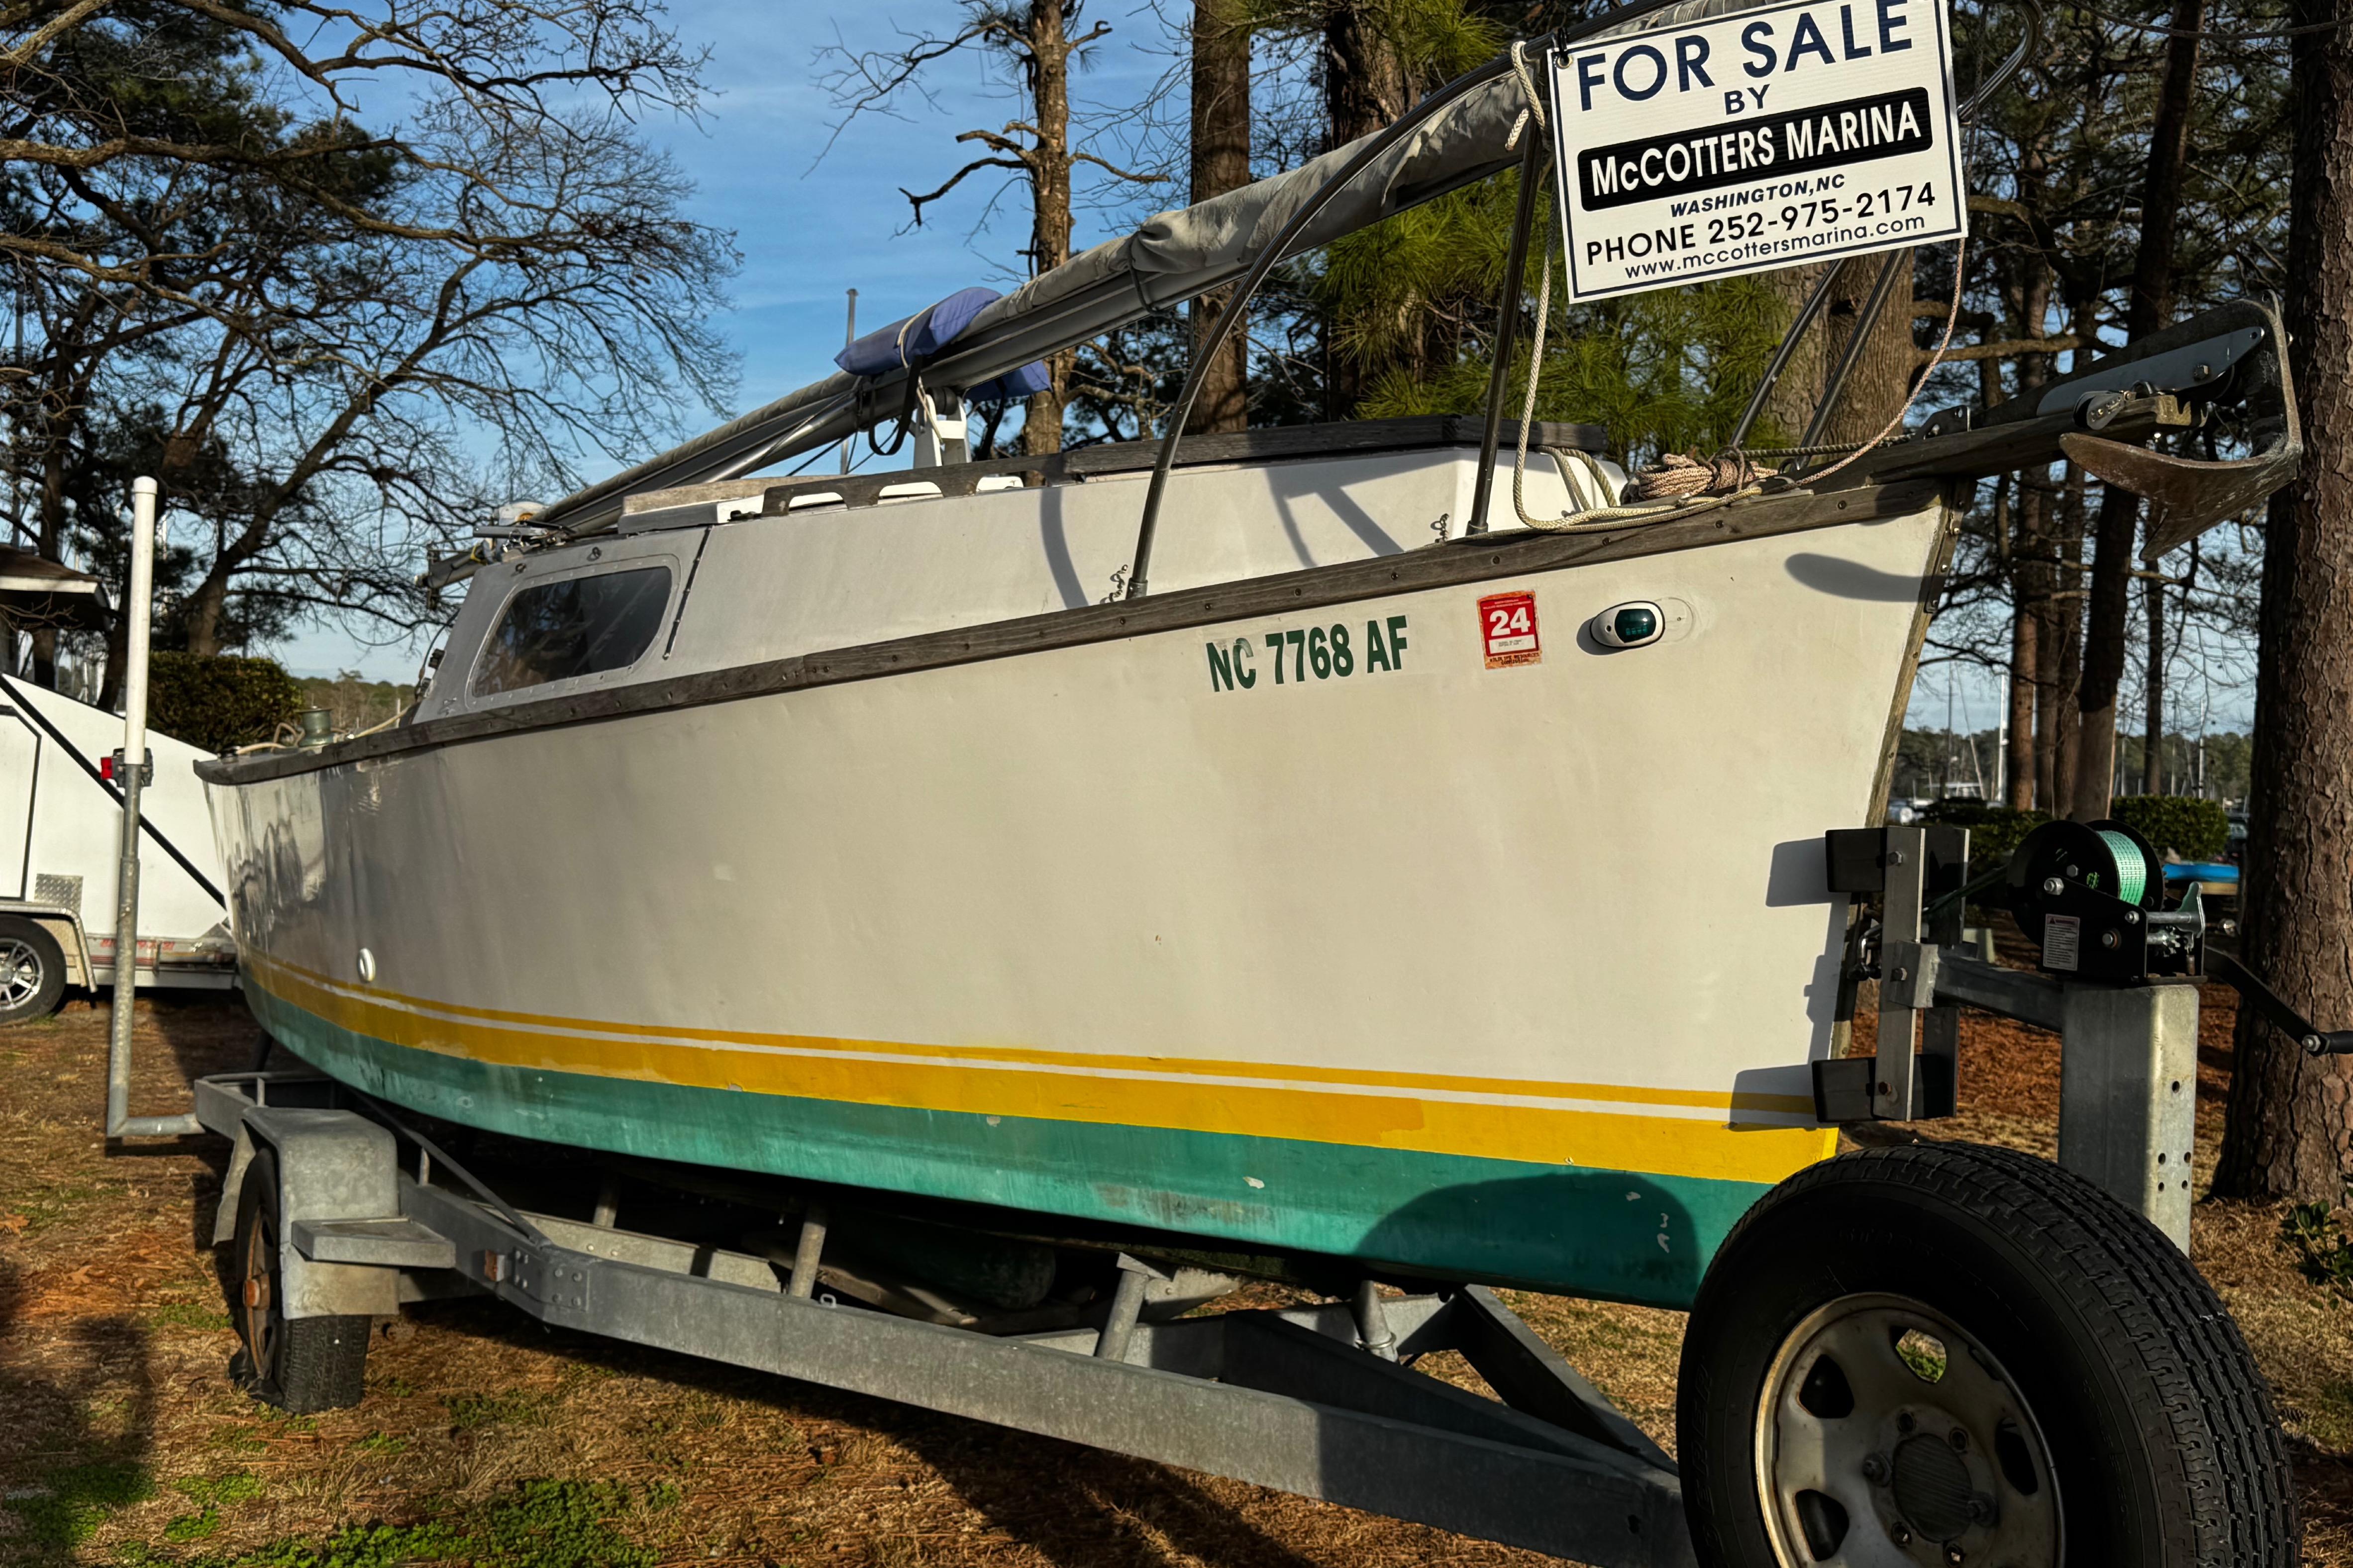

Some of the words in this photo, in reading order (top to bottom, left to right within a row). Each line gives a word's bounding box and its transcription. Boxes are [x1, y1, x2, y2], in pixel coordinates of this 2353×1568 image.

[1577, 35, 1715, 111] FOR
[1741, 0, 1913, 78] SALE
[1724, 84, 1770, 115] BY
[1591, 126, 1775, 196] McCOTTERS
[1785, 101, 1922, 160] MARINA
[1587, 224, 1696, 265] PHONE
[1709, 182, 1936, 245] 252-975-2174
[1670, 174, 1845, 217] WASHINGTON,NC
[1625, 215, 1925, 279] www.mccottersmarina.com
[1206, 638, 1256, 692] NC
[1265, 623, 1354, 685] 7768
[1366, 615, 1408, 673] AF
[1490, 607, 1531, 636] 24
